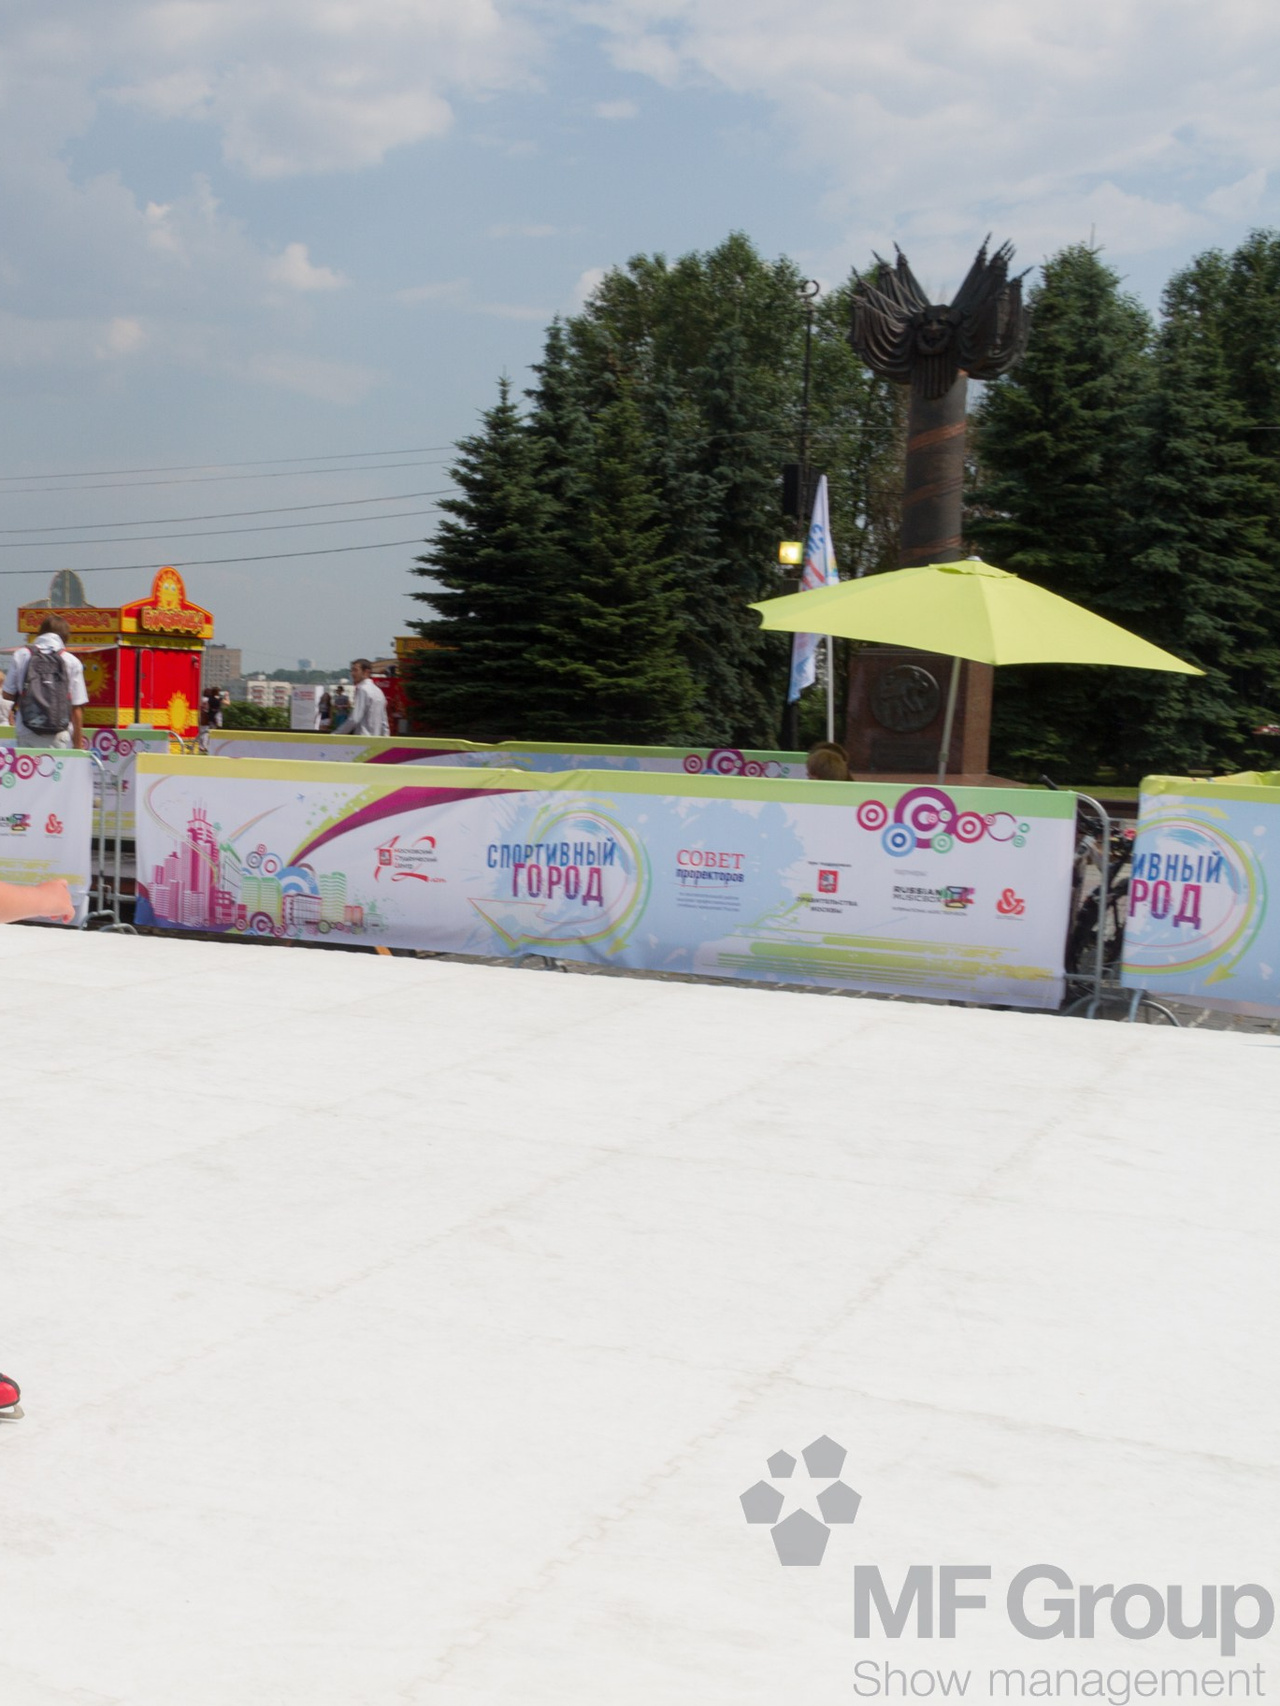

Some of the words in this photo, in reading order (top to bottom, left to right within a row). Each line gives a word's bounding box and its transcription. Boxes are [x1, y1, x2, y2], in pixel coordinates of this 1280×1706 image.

[487, 837, 617, 869] СПОРТИВНЫЙ
[676, 849, 747, 870] СОВЕТ
[512, 862, 604, 907] ГОРОД
[676, 868, 745, 886] проректоров
[1128, 878, 1203, 930] РОД
